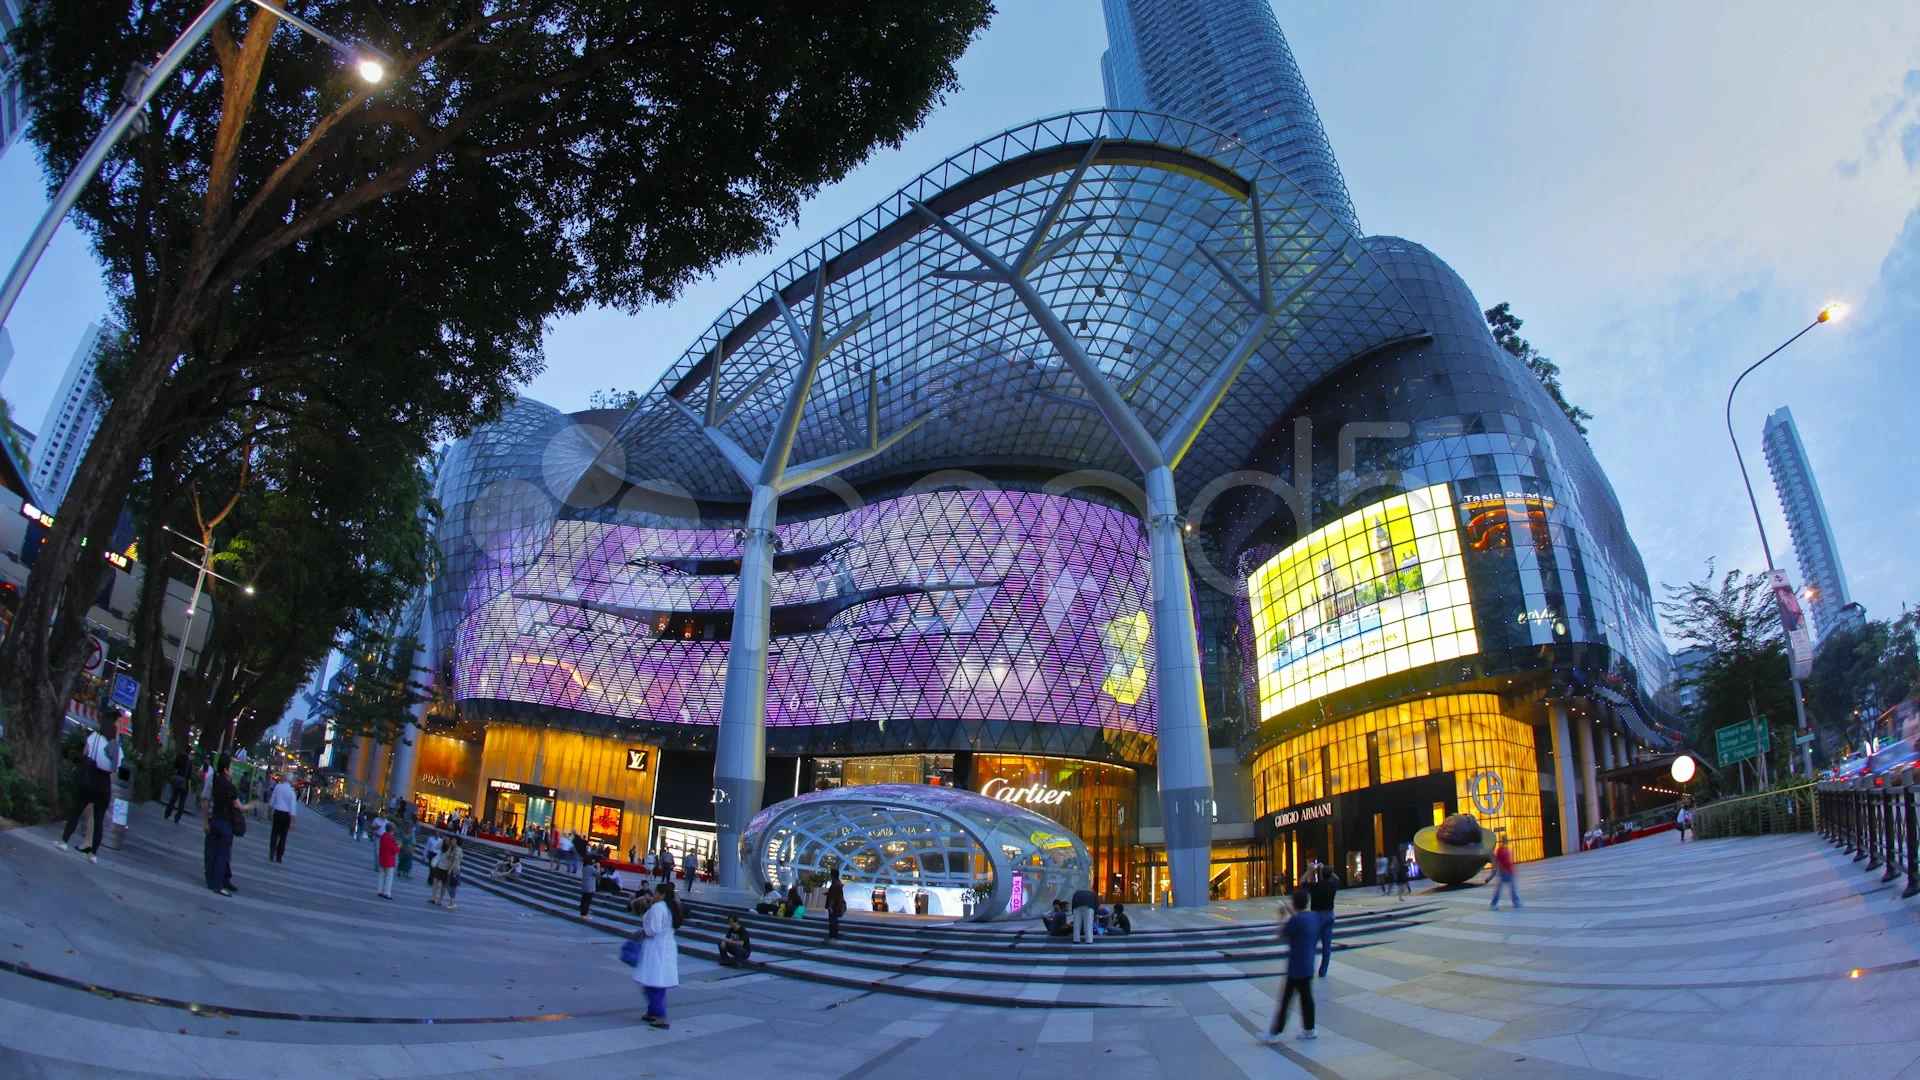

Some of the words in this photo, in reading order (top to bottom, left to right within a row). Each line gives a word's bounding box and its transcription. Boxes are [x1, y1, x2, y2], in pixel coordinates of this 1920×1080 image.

[1464, 492, 1501, 503] Taste
[1368, 632, 1398, 647] mies
[422, 773, 455, 789] PRADA
[980, 777, 1071, 805] Cartier
[1274, 810, 1299, 828] GIORGIO
[1301, 802, 1332, 822] ARMANI
